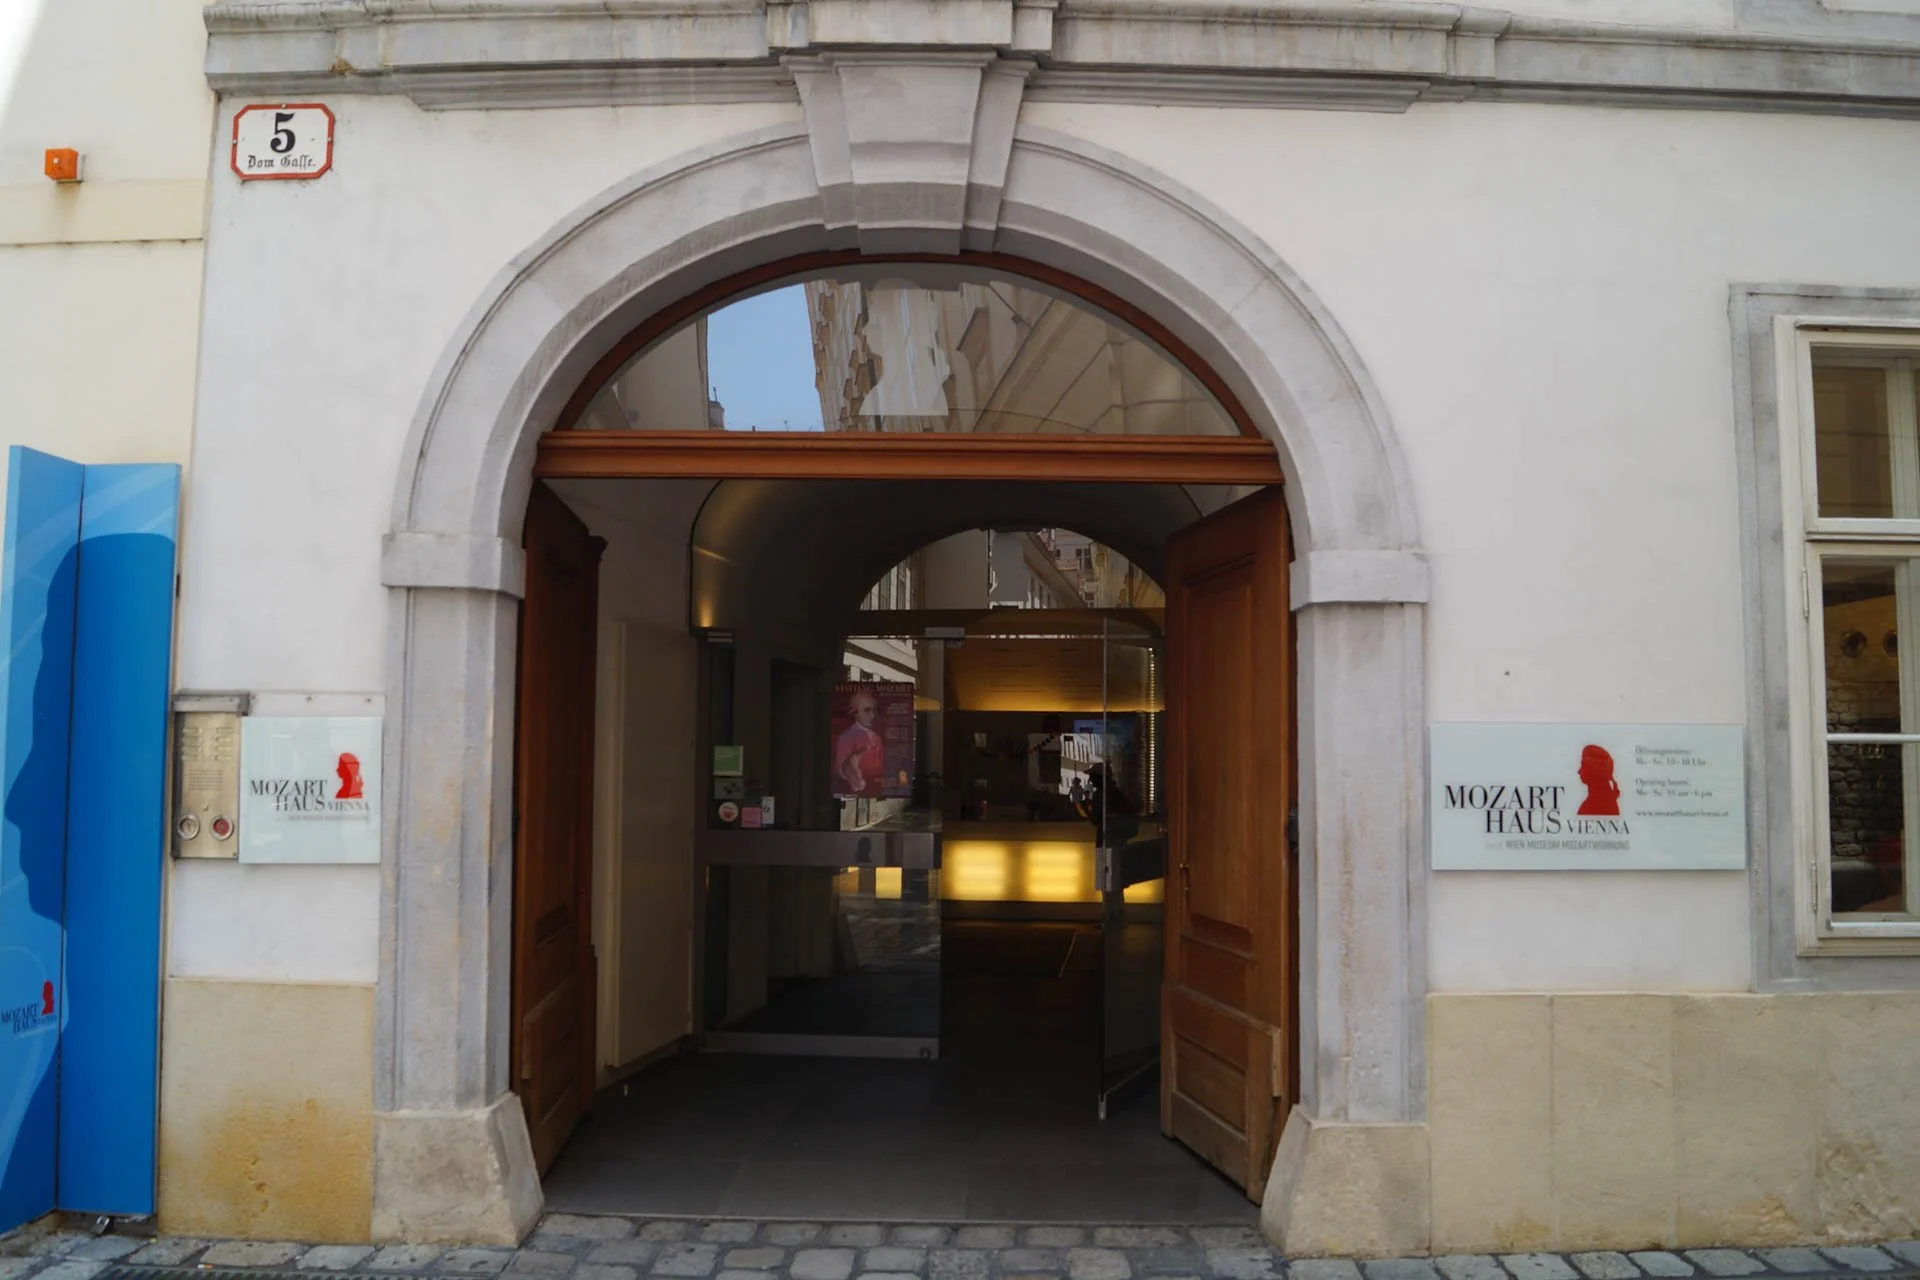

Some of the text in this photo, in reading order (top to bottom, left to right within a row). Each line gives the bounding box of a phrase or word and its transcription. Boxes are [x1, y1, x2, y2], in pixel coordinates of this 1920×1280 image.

[270, 112, 296, 153] 5
[248, 155, 274, 169] Dom
[250, 779, 327, 797] MOZART
[1443, 785, 1565, 809] MOZART
[275, 796, 325, 812] HAUS
[1485, 808, 1630, 834] HAUS VIENNA
[1, 1003, 39, 1024] MOZART
